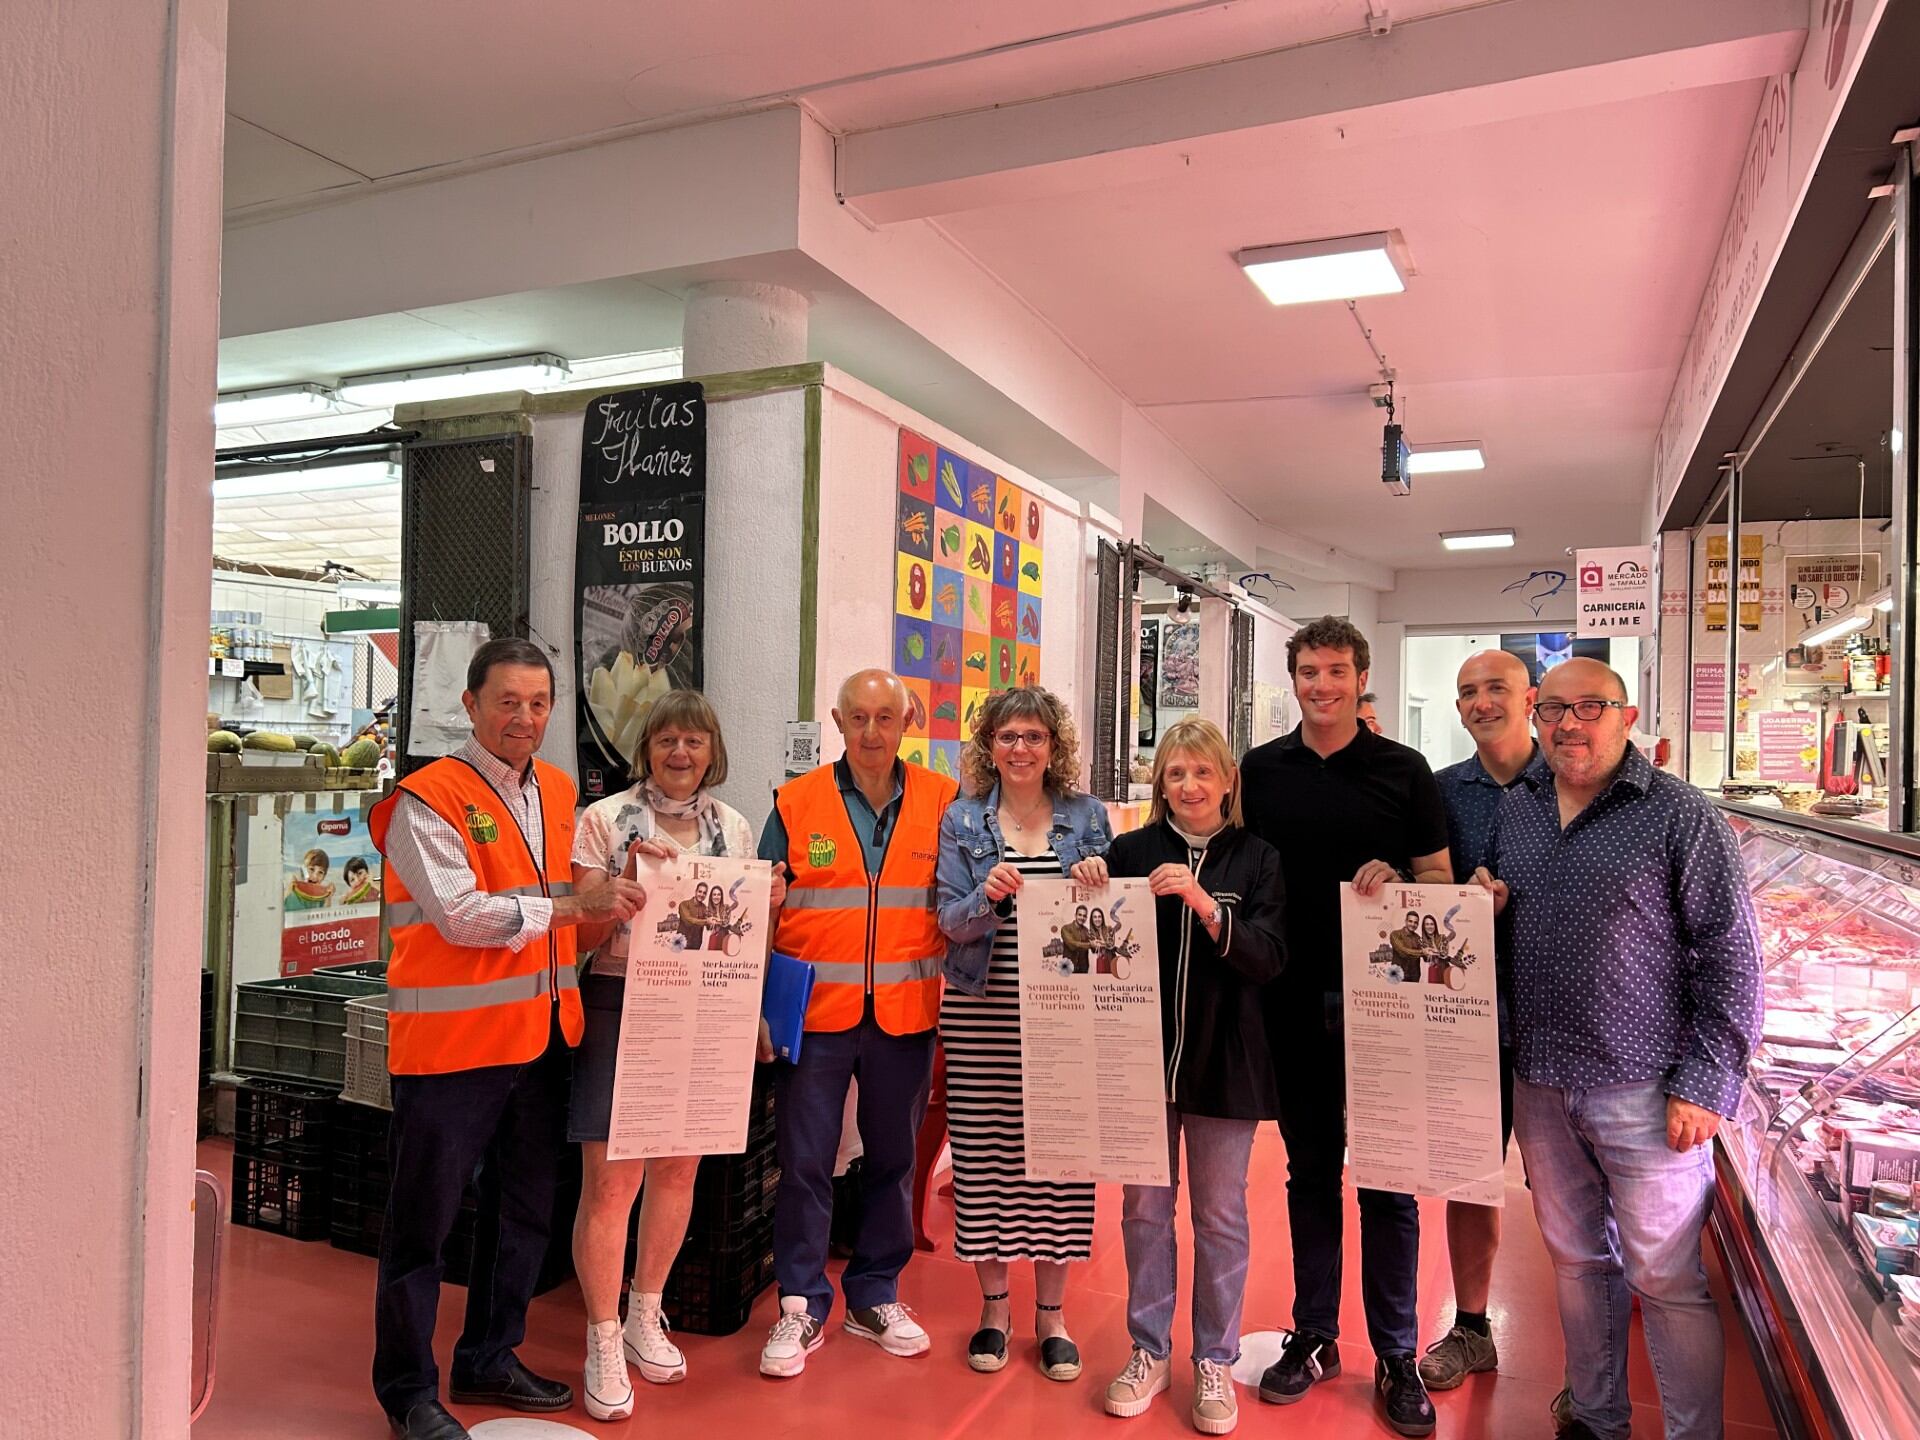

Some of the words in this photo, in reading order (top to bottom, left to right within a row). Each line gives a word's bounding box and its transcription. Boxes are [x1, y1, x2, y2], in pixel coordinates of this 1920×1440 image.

[592, 394, 698, 444] Frutas
[584, 512, 616, 521] MELONES
[603, 518, 684, 546] BOLLO
[619, 547, 654, 562] ÉSTOS
[658, 547, 682, 560] SON
[623, 562, 640, 571] LOS
[641, 558, 693, 573] BUENOS
[1608, 572, 1648, 580] MERCADO
[1798, 574, 1807, 582] NO
[1808, 573, 1823, 582] SABE
[1825, 573, 1832, 581] LO
[1833, 573, 1846, 581] QUE
[1749, 582, 1760, 590] TU
[1583, 600, 1646, 612] CARNICERÍA
[1589, 616, 1641, 627] JAIME
[645, 610, 680, 662] BOLLO
[299, 932, 308, 944] el
[311, 927, 351, 942] bocado
[312, 943, 333, 955] más
[336, 939, 364, 951] dulce
[702, 960, 759, 969] Merkataritza
[637, 968, 688, 976] Comercio
[701, 970, 750, 979] Turismoa
[645, 977, 691, 986] Turismo
[1093, 984, 1153, 992] Merkataritza
[1028, 991, 1080, 1001] Comercio
[1092, 993, 1146, 1003] Turismoa
[1352, 989, 1398, 1000] Semana
[1039, 1000, 1085, 1010] Turismo
[1353, 998, 1410, 1009] Comercio
[1424, 994, 1490, 1006] Merkataritza
[1095, 1003, 1123, 1011] Astea
[1424, 1004, 1481, 1017] Turismoa
[1365, 1008, 1414, 1020] Turismo
[1424, 1014, 1456, 1024] Astea
